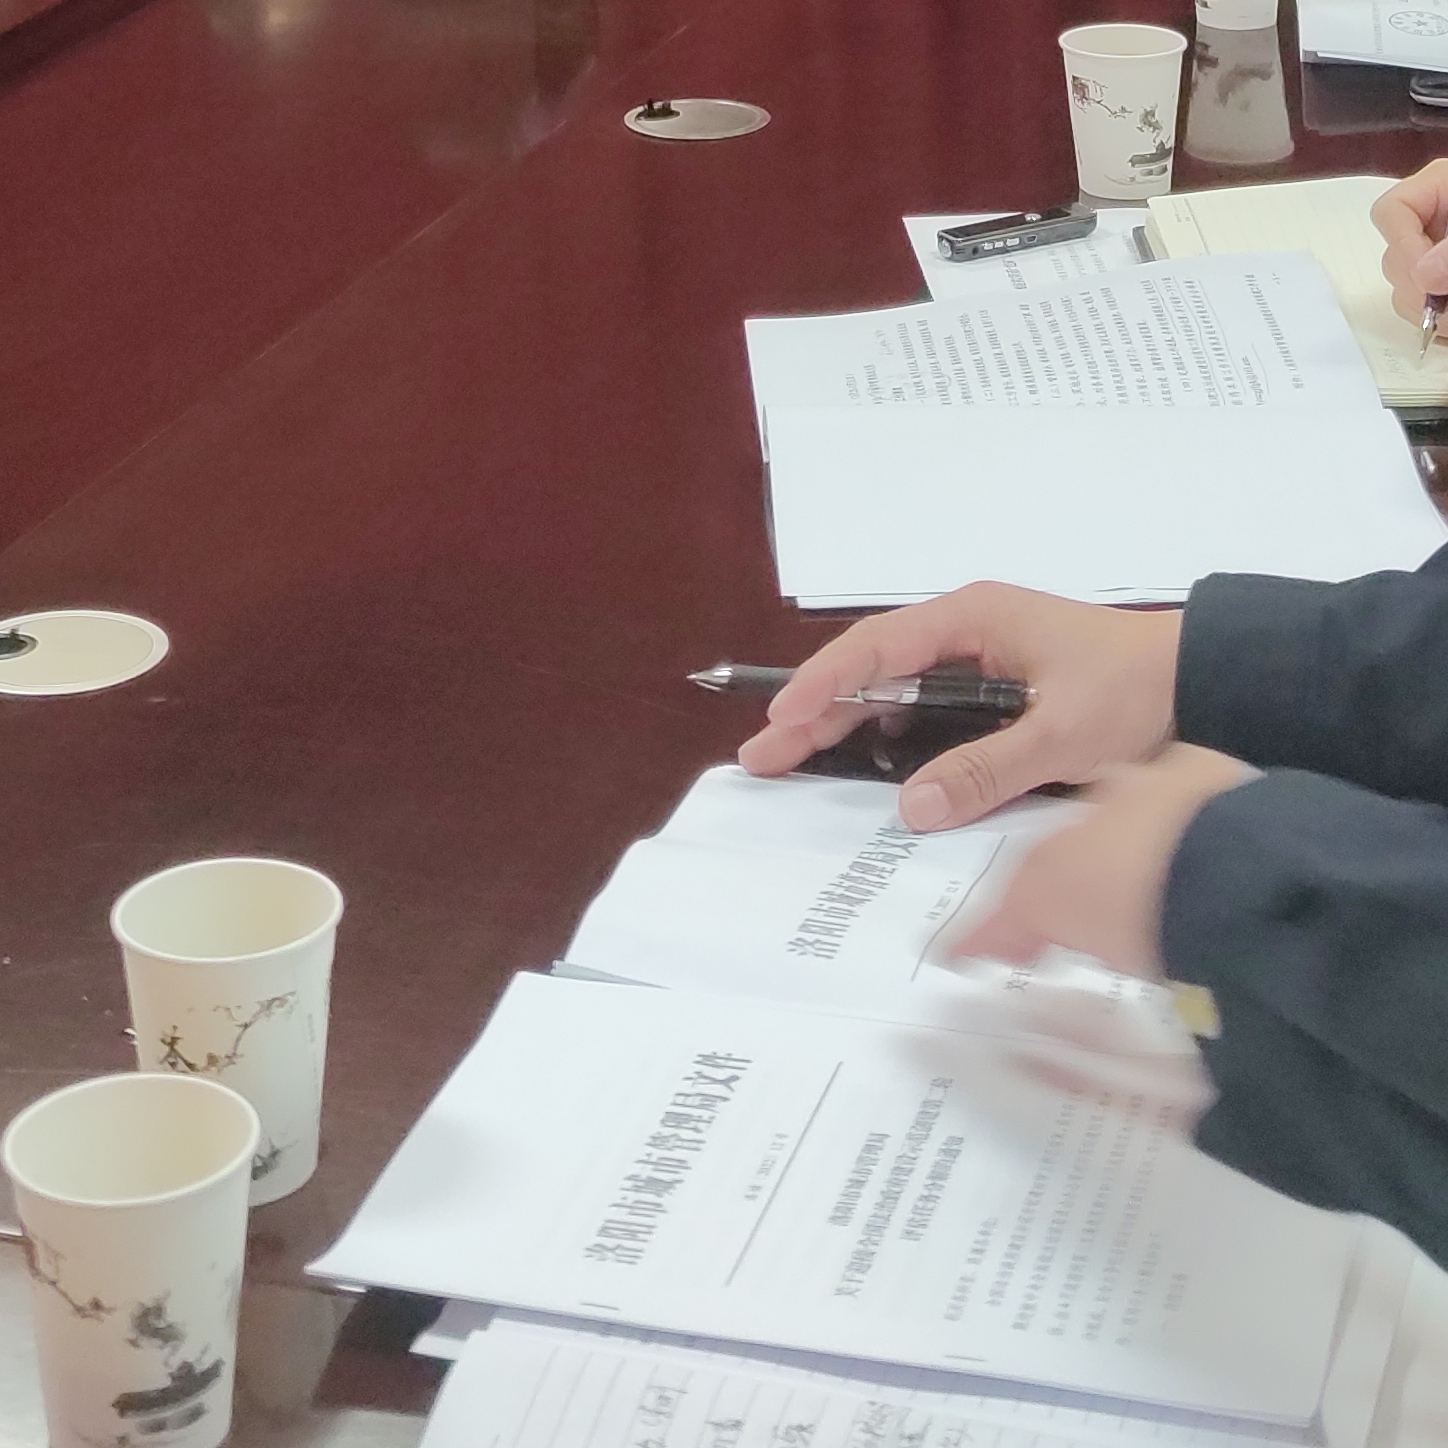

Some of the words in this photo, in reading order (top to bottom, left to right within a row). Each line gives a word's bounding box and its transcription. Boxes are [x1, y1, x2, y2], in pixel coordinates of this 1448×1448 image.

[583, 1051, 753, 1266] 洛阳市城市管理局文件
